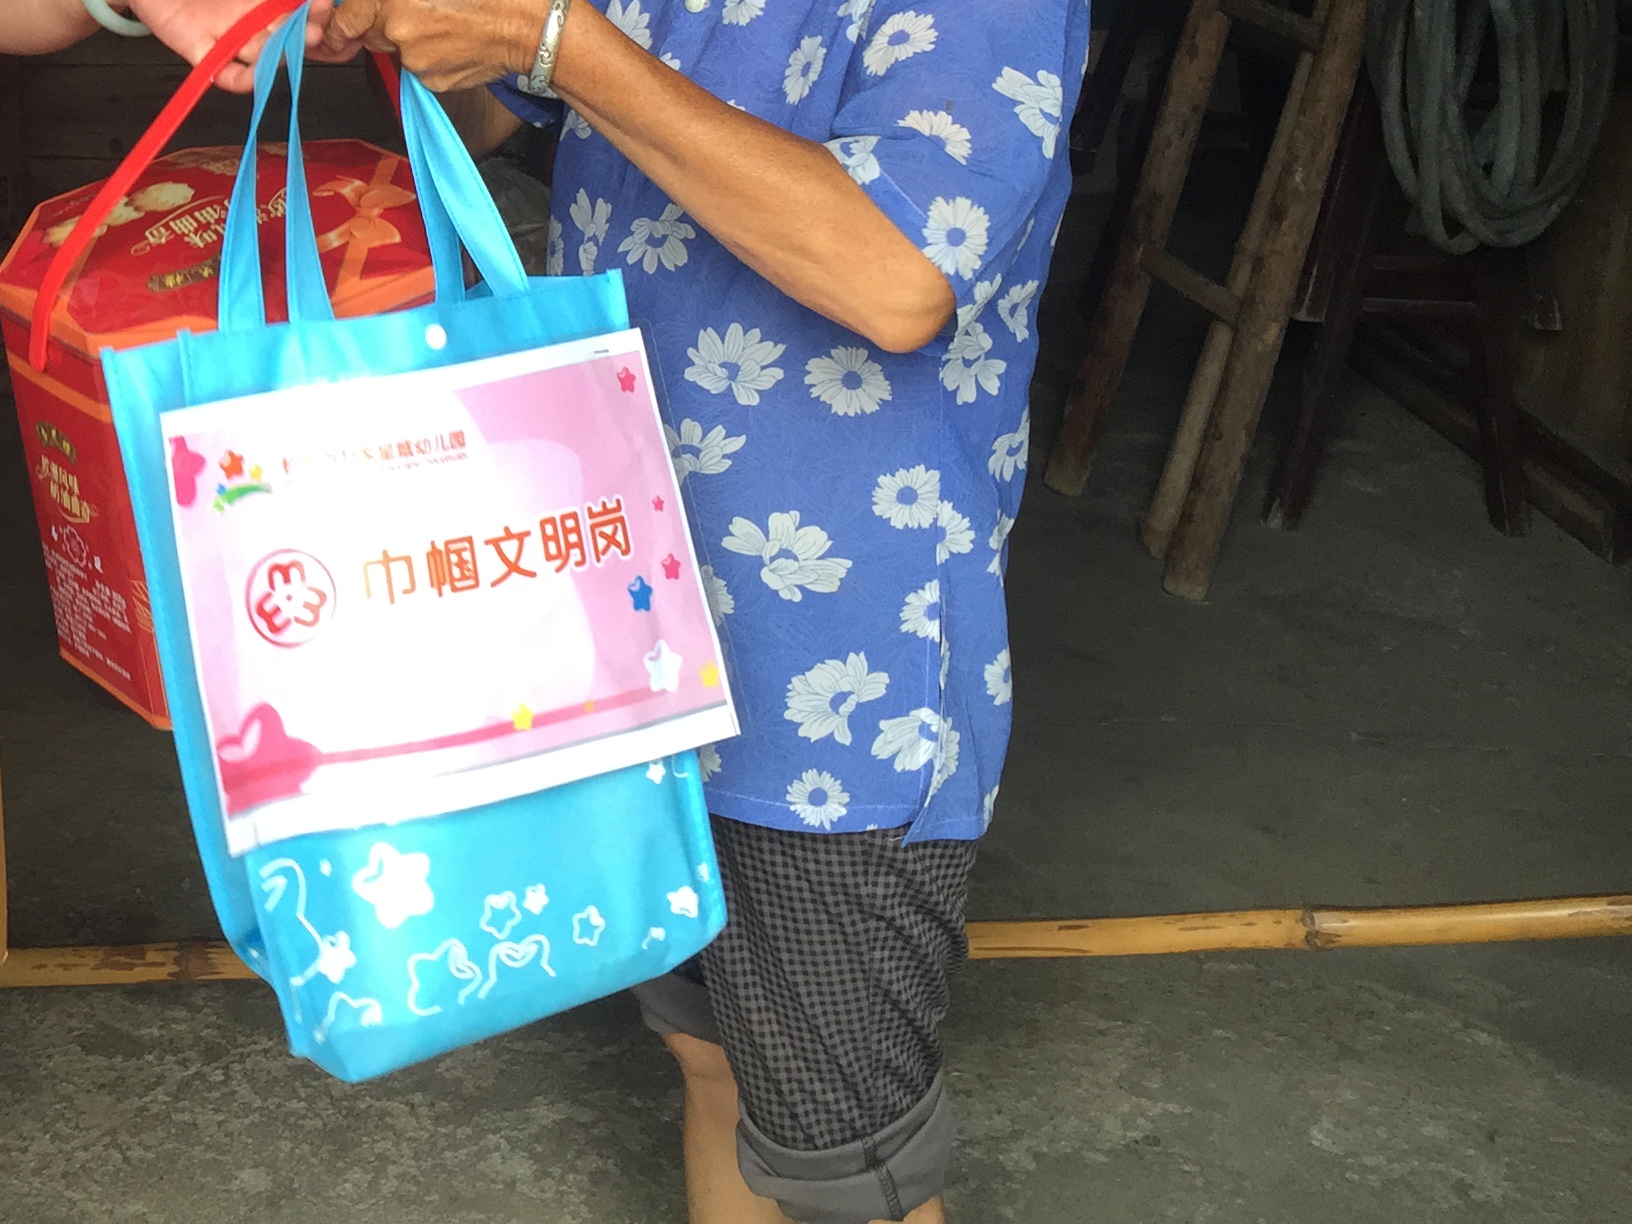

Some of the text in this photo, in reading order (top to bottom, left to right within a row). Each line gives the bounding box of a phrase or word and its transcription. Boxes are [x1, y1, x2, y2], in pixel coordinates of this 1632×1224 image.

[363, 499, 632, 604] 巾帼文明岗
